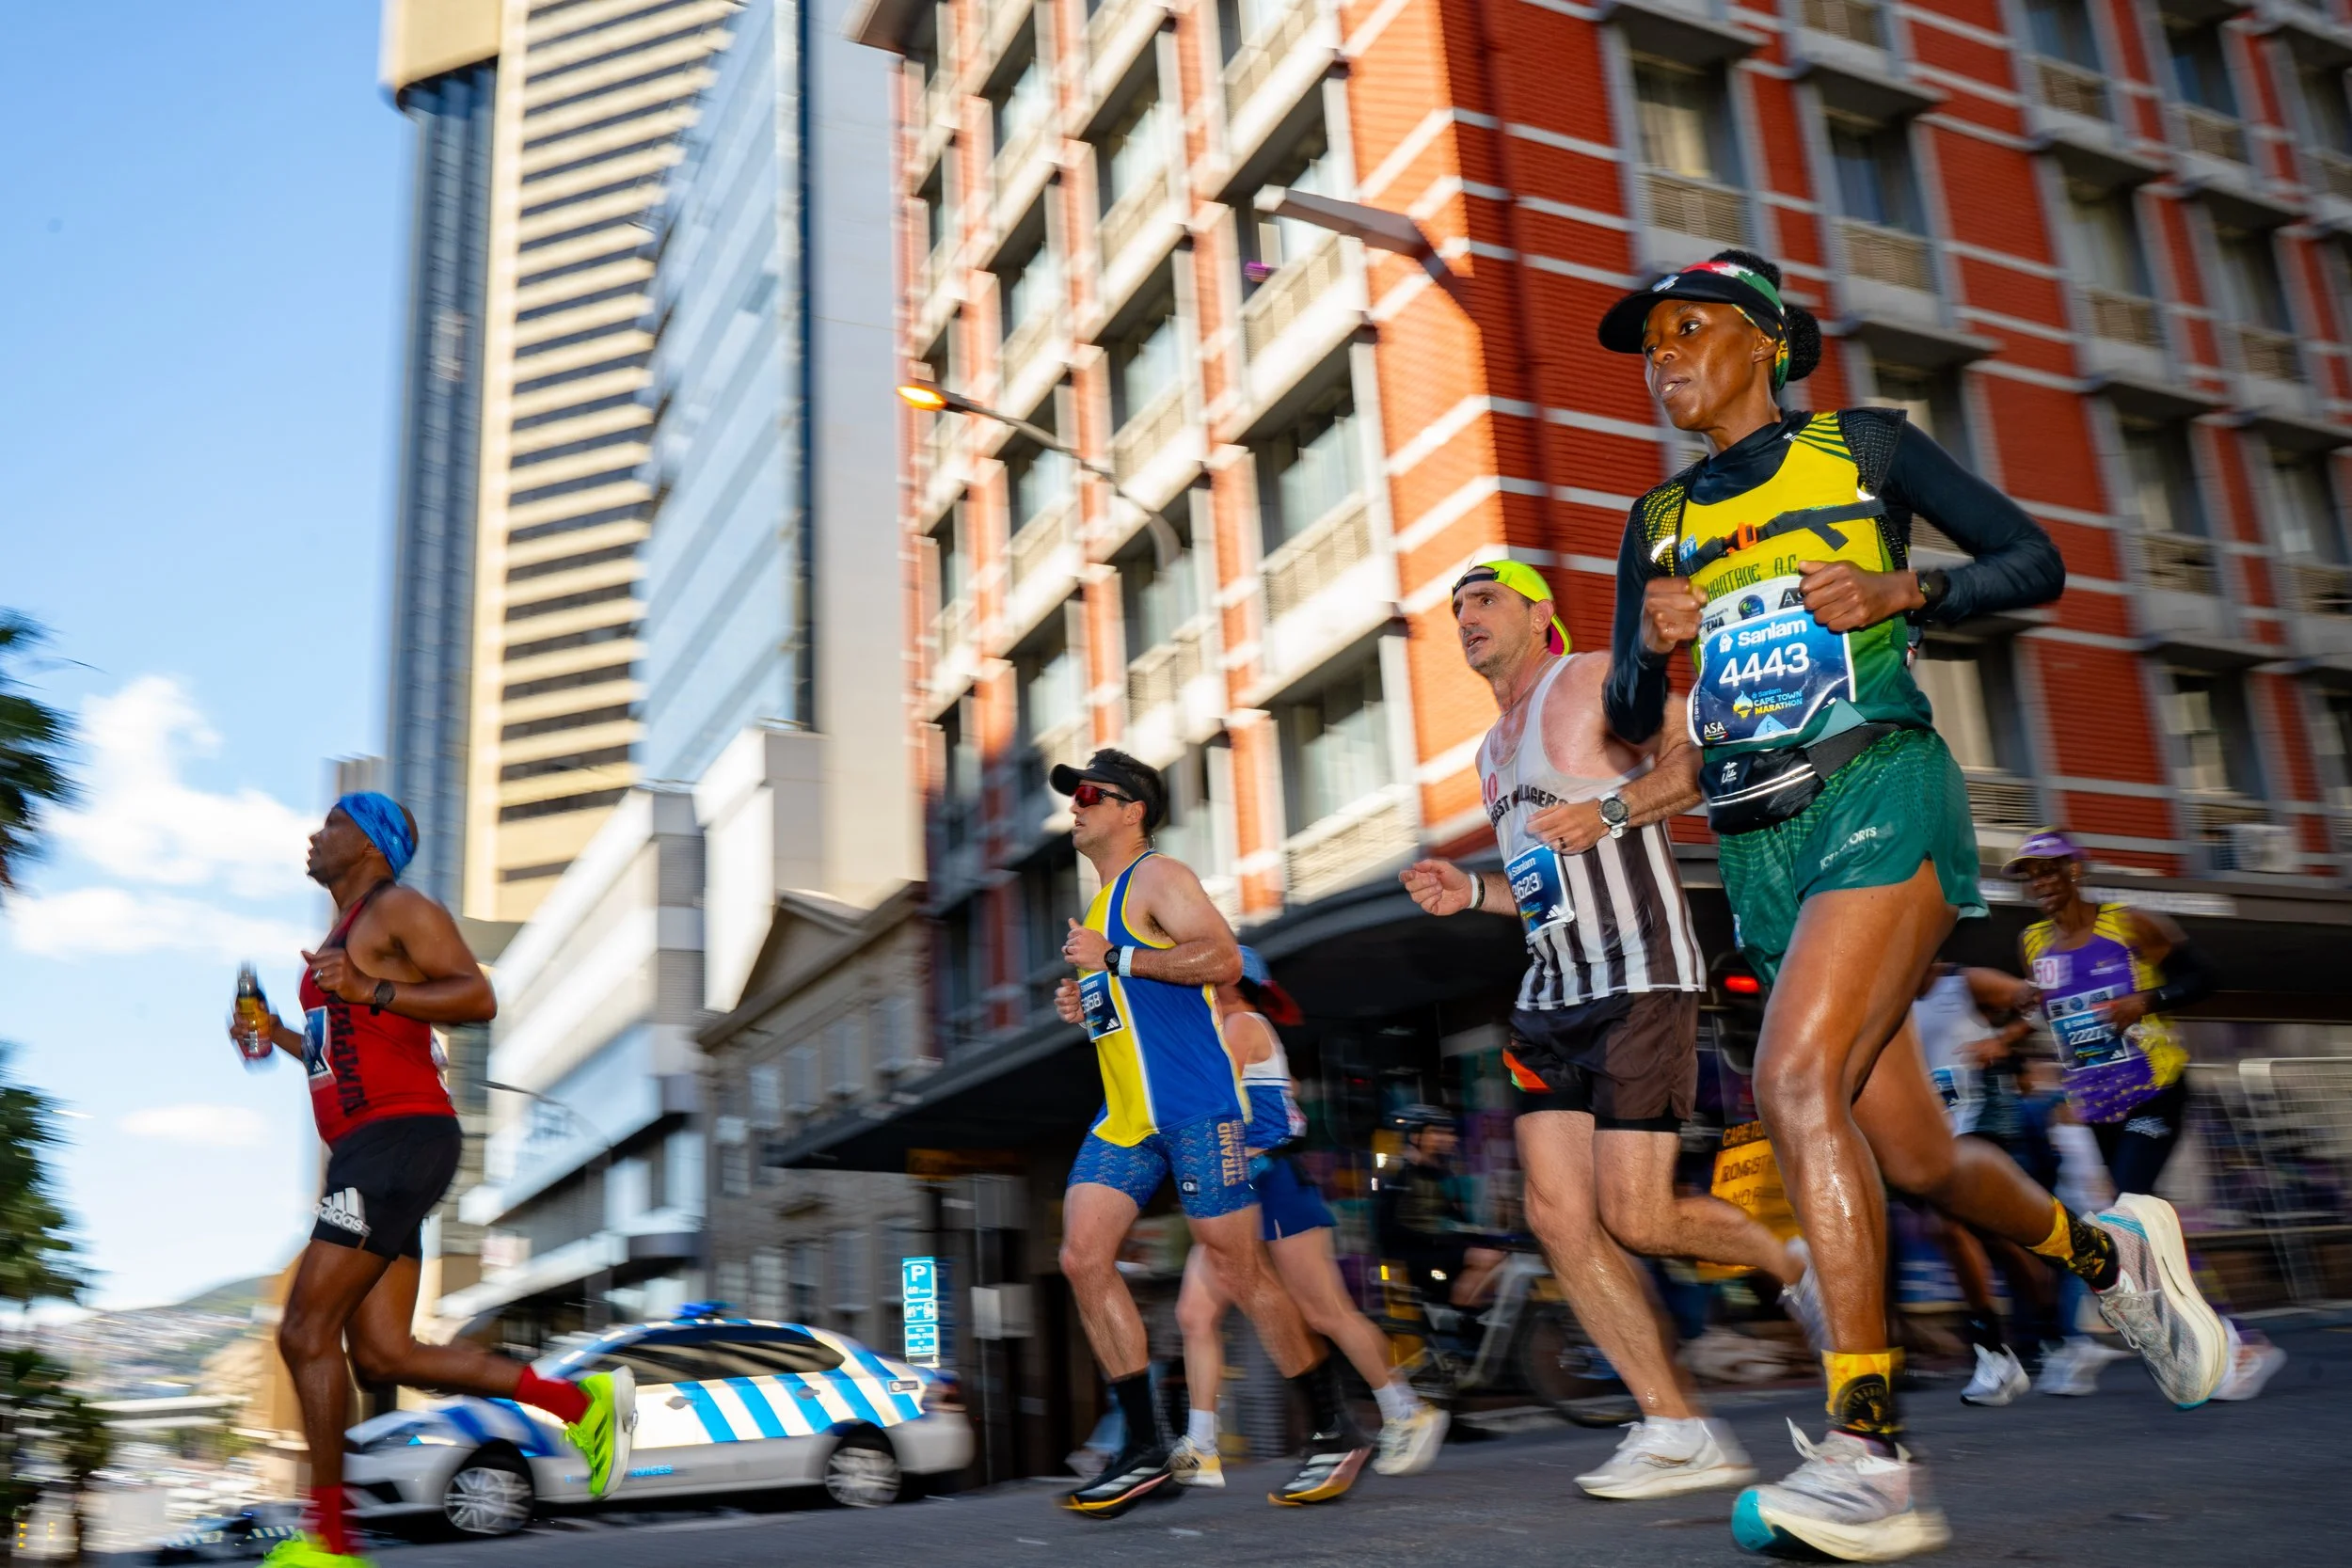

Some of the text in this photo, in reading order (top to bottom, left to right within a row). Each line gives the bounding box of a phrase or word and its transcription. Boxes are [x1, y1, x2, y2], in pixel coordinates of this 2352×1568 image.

[1738, 620, 1807, 647] Sanlam
[1719, 642, 1810, 688] 4443
[1754, 690, 1802, 706] CAPE TOWN
[1758, 688, 1782, 697] Sanlam
[1755, 698, 1803, 715] MARATHON
[1704, 721, 1724, 736] ASA
[1511, 857, 1536, 877] Sanlam
[1216, 1122, 1237, 1187] STRAND
[311, 1203, 365, 1233] adidas
[911, 1264, 927, 1282] P
[631, 1465, 674, 1477] RVICES
